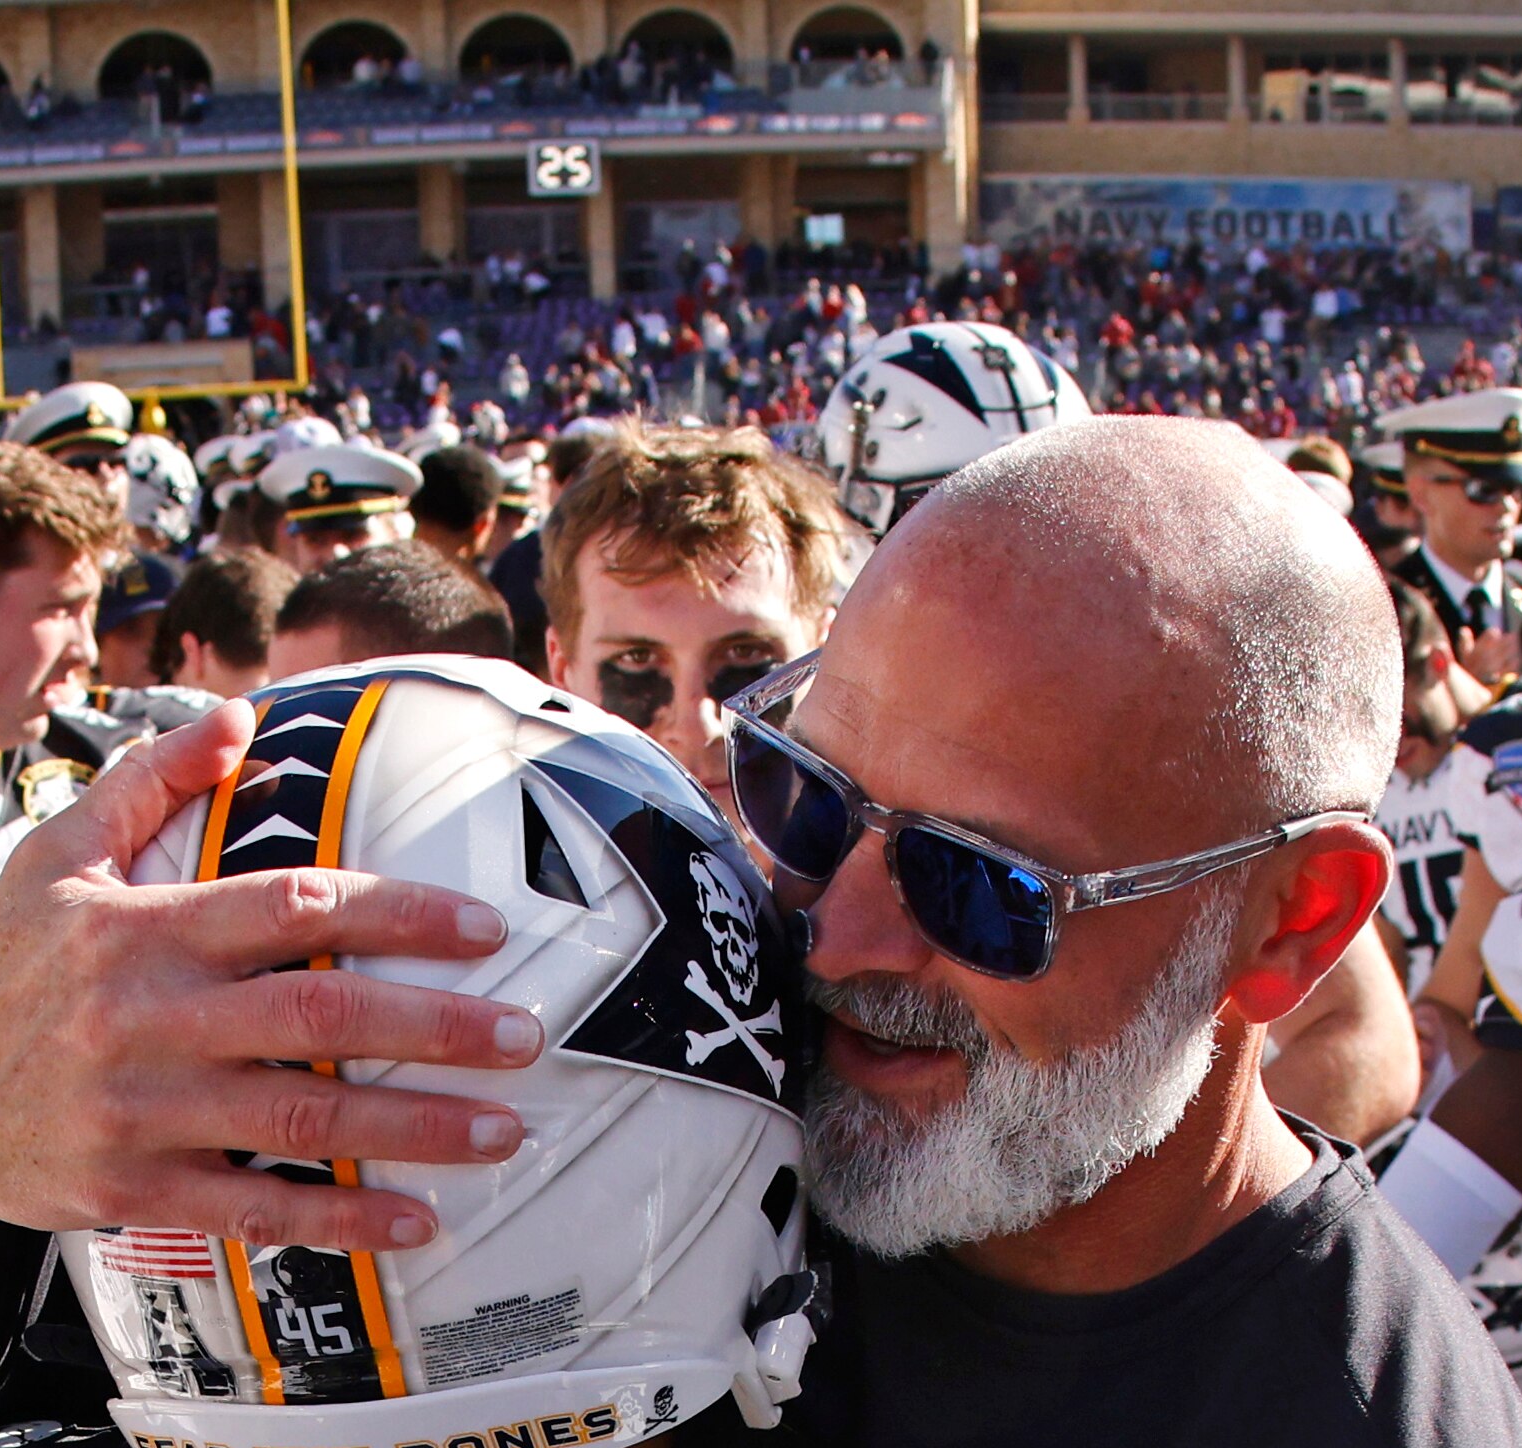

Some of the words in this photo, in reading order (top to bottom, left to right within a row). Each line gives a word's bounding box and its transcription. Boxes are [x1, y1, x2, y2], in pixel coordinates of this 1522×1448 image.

[536, 143, 592, 189] 25
[1053, 208, 1170, 243] NAVY
[1186, 208, 1409, 242] FOOTBALL
[475, 1294, 531, 1316] WARNING
[277, 1301, 353, 1360] 45
